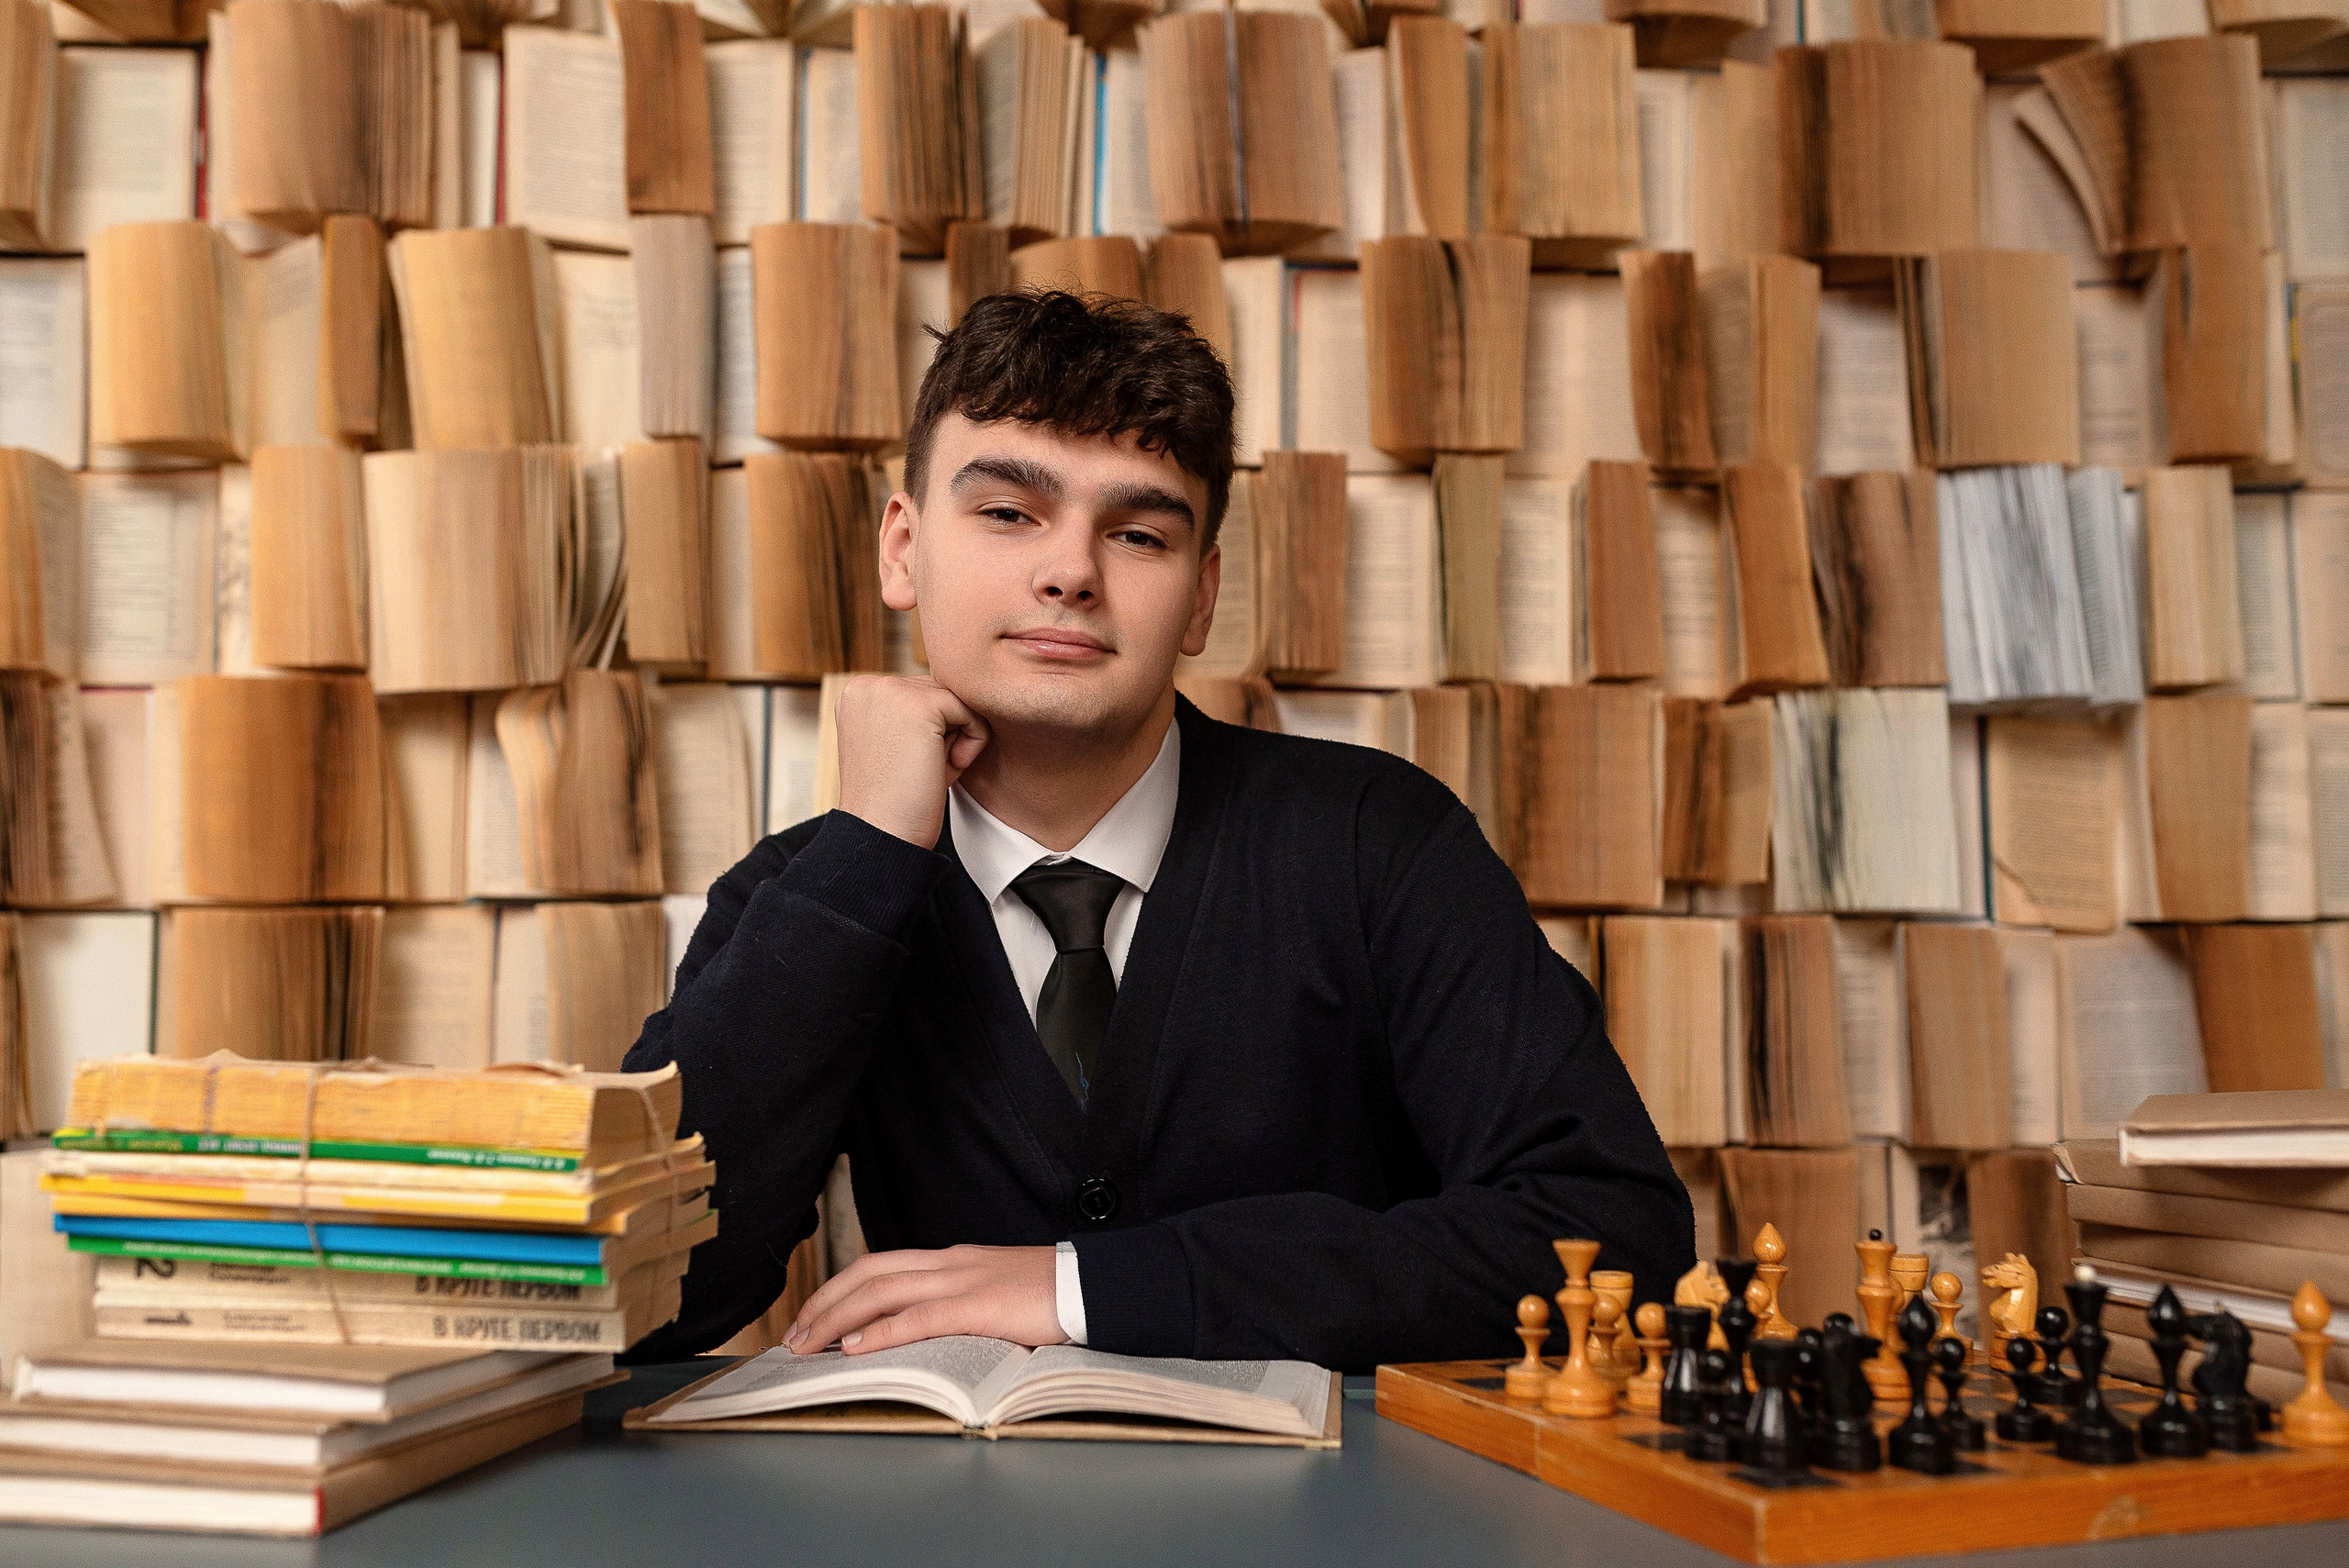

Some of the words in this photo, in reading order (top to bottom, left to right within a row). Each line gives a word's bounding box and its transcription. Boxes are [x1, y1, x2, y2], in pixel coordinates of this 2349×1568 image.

[432, 1315, 448, 1339] В
[452, 1316, 511, 1340] КРУГЕ
[518, 1318, 602, 1343] ПЕРВОМ
